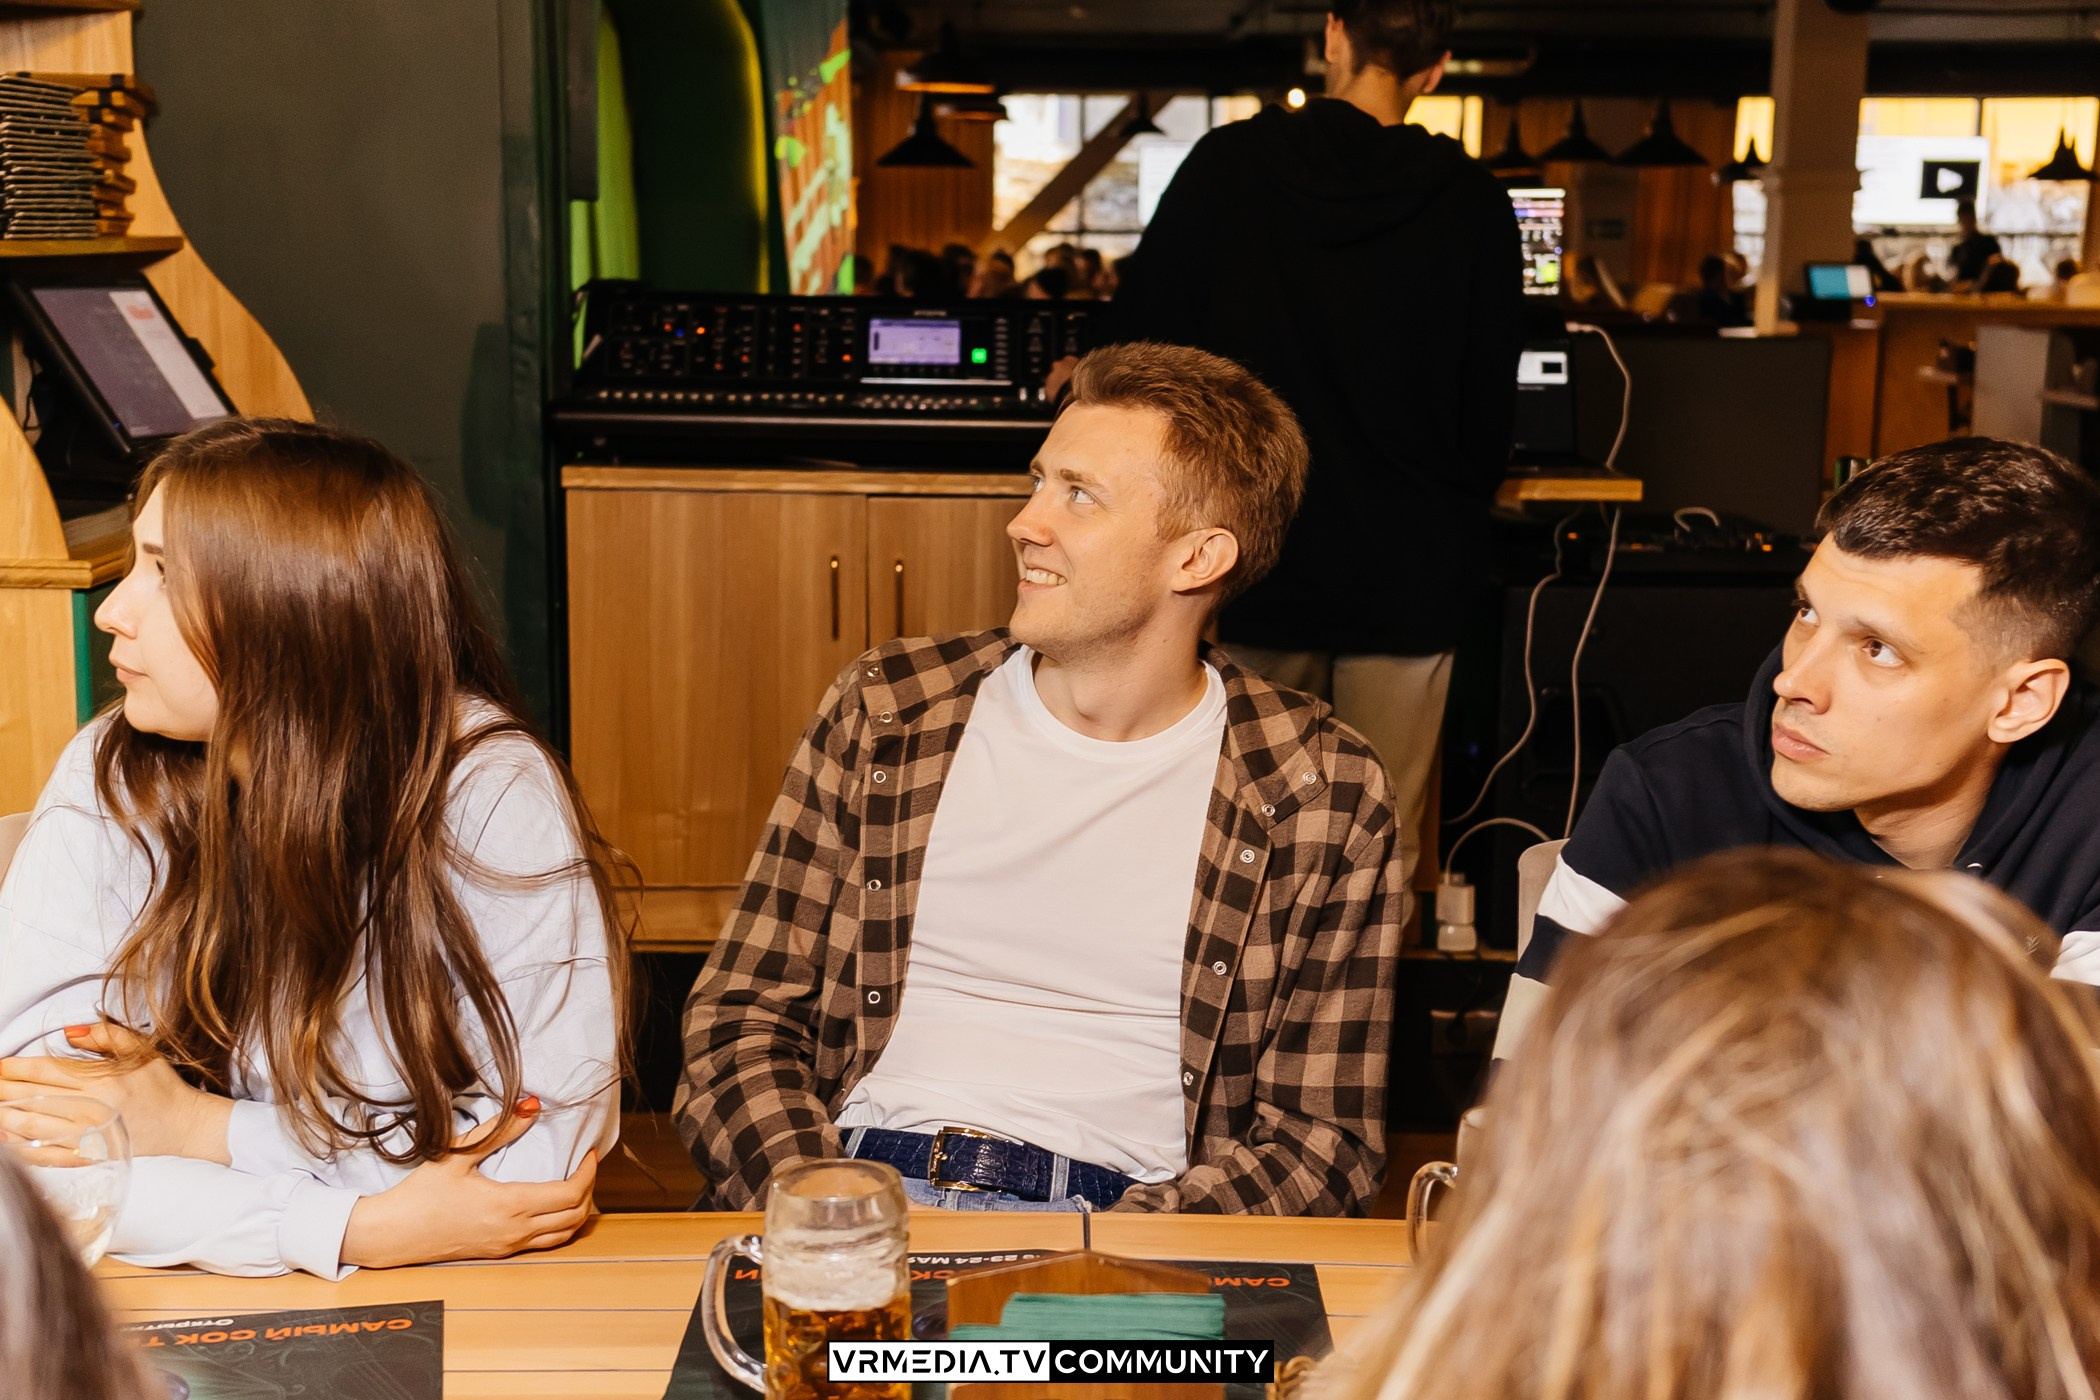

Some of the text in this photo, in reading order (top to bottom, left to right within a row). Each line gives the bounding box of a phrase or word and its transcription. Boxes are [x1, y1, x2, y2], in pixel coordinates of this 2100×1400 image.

[955, 1254, 1018, 1265] 23-24
[910, 1269, 962, 1280] ОК
[1214, 1277, 1290, 1288] САМ
[264, 1318, 413, 1341] САМЫЙ
[175, 1329, 256, 1346] СОК
